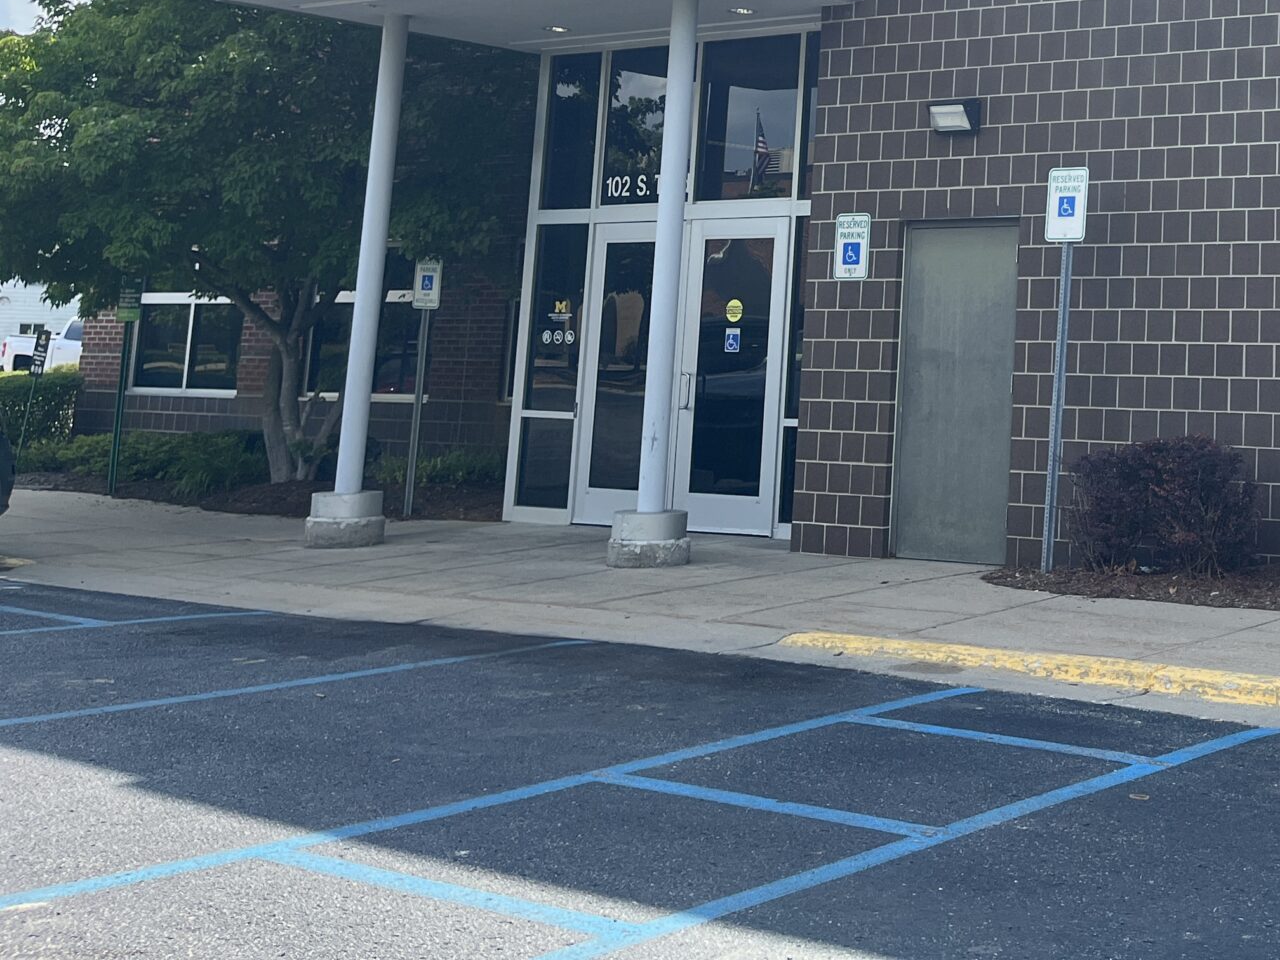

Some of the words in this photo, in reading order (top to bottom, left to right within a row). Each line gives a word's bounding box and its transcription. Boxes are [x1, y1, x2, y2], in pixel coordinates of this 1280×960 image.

[1052, 174, 1085, 184] RESERVED
[606, 175, 631, 197] 102
[636, 174, 650, 196] S.
[1055, 185, 1082, 193] PARKING
[838, 220, 868, 229] RESERVED
[840, 231, 866, 240] PARKING
